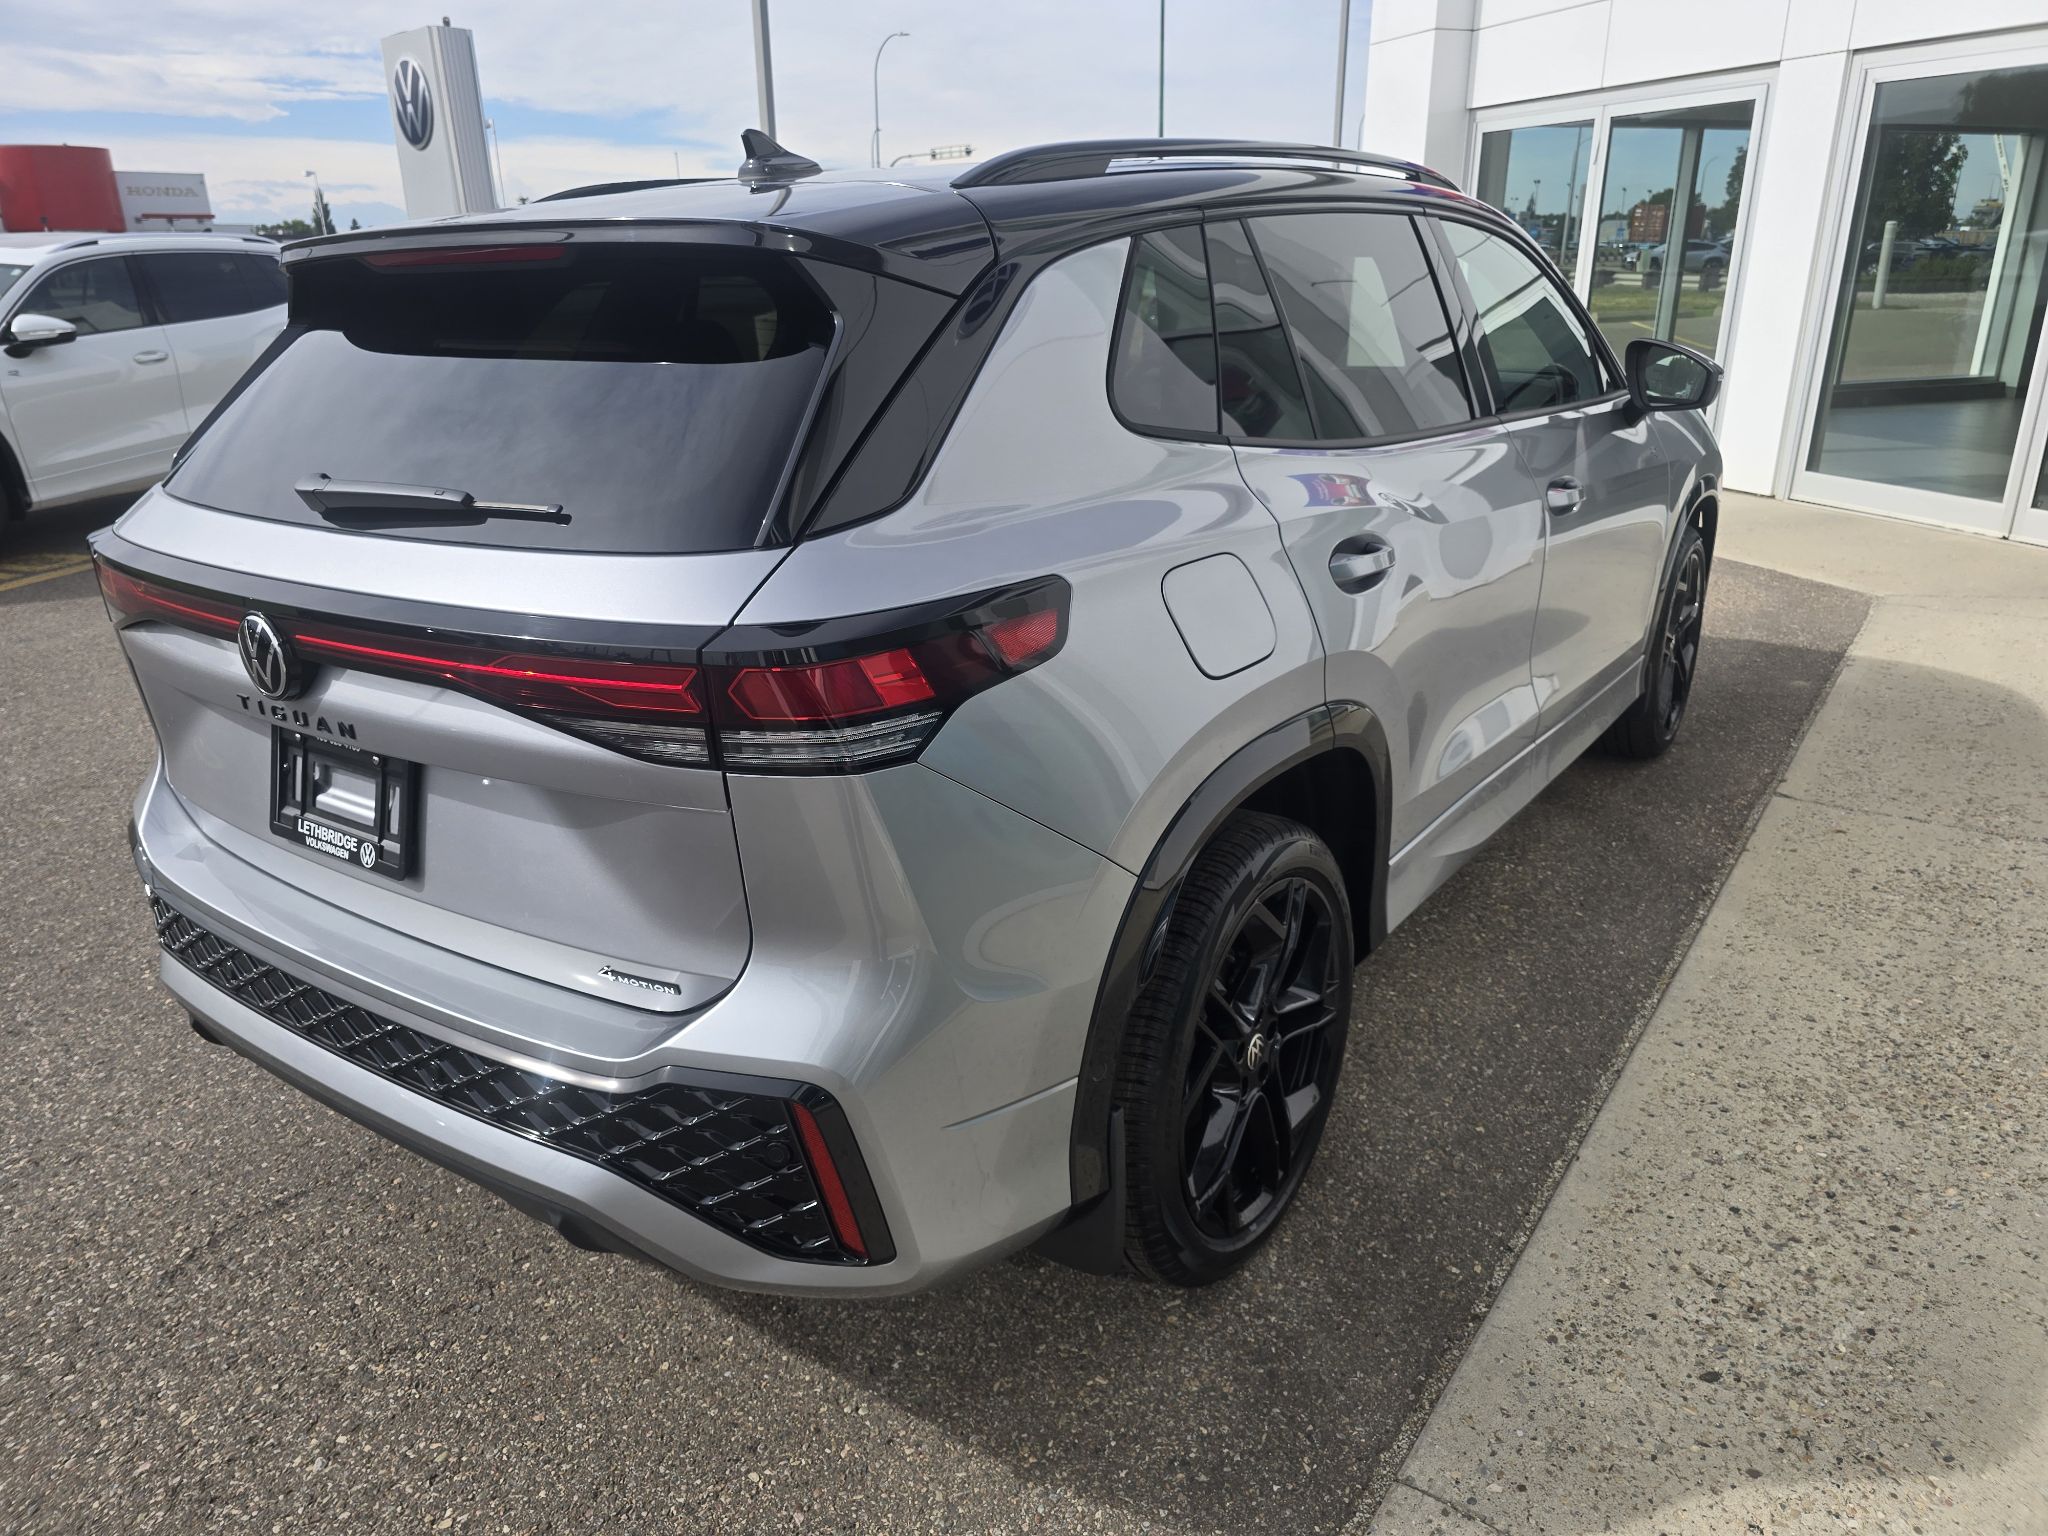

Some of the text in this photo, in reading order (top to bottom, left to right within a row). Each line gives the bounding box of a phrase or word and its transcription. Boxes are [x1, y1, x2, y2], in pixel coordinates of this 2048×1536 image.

[125, 185, 199, 197] HONDA
[236, 694, 357, 740] TIGUAN
[297, 818, 358, 852] LETHBRIDGE
[305, 835, 350, 860] VOLKSWAGEN
[598, 965, 676, 996] 4MOTION
